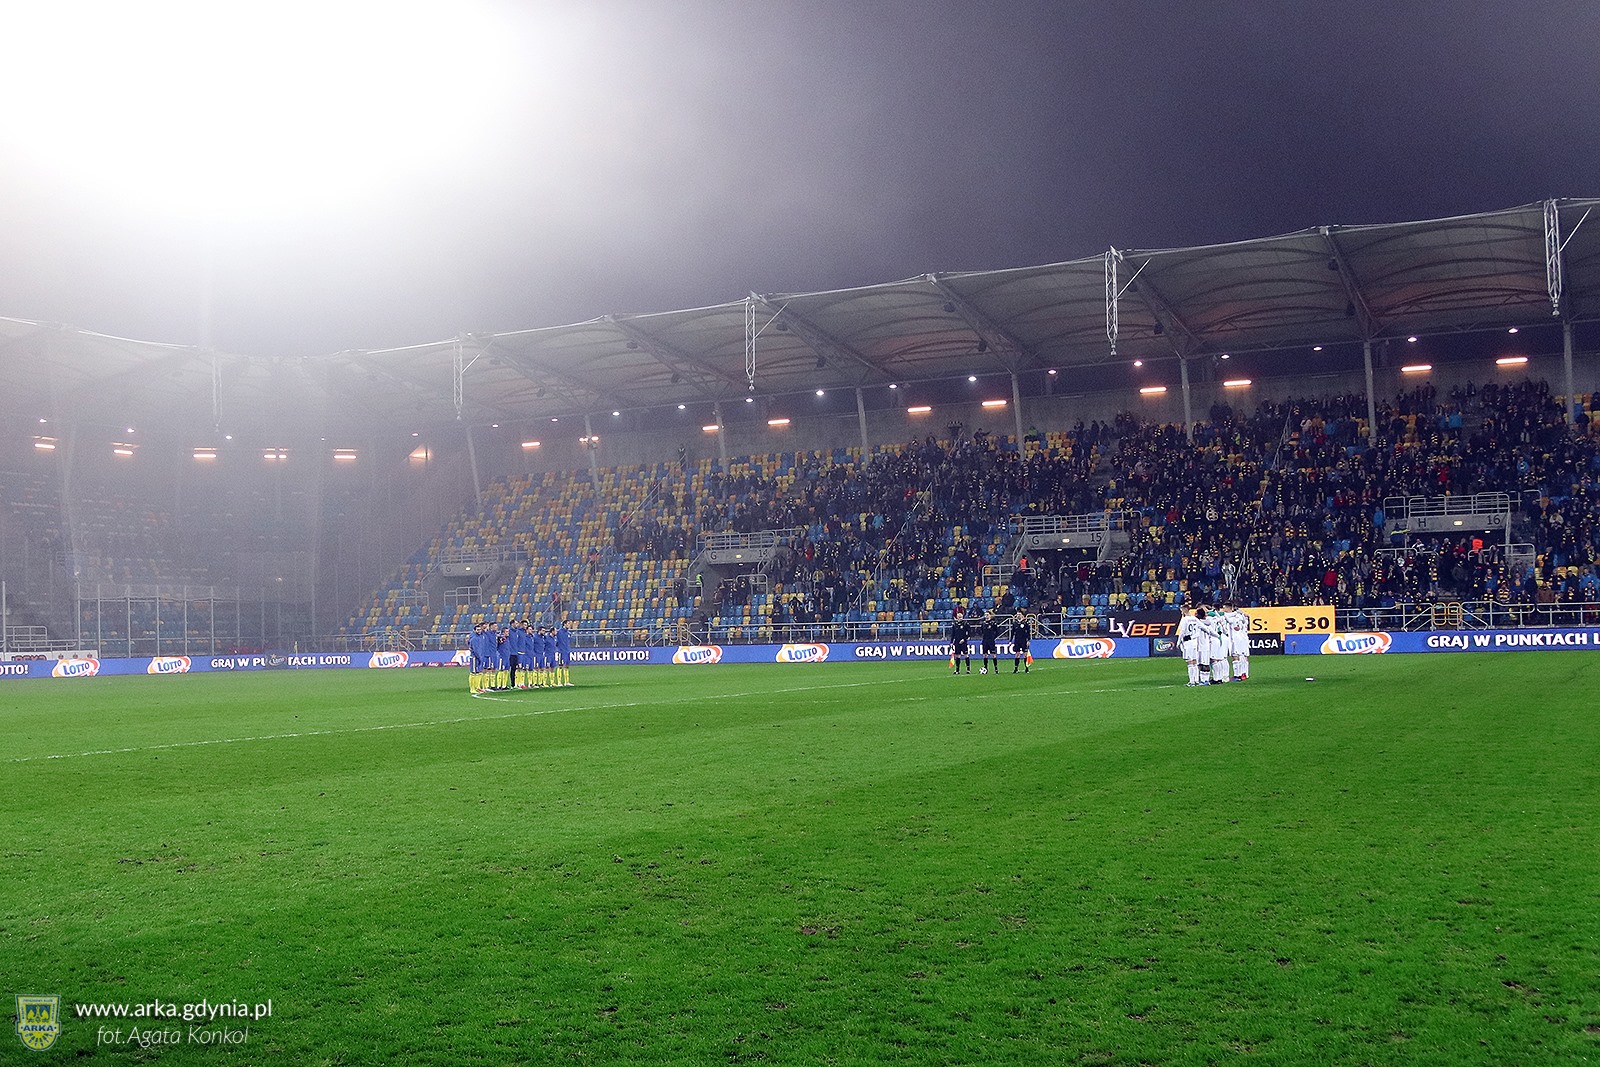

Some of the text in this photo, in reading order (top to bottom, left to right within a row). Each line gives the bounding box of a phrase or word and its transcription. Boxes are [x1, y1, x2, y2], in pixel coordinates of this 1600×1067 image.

[1487, 516, 1500, 525] 16
[1032, 533, 1102, 545] G 15
[710, 551, 717, 560] G
[1284, 617, 1330, 632] 3,30
[1336, 636, 1376, 652] LOTTO
[1427, 635, 1468, 650] GRAJ
[1474, 634, 1491, 647] W
[1498, 633, 1588, 646] PUNKTACH
[555, 650, 649, 661] NKTACH LOTTO!
[683, 648, 712, 662] LOTTO
[788, 647, 817, 660] LOTTO
[855, 646, 887, 659] GRAJ
[889, 645, 903, 656] W
[906, 644, 976, 656] PUNKTH
[1066, 641, 1102, 657] LOTTO
[157, 660, 182, 672] LOTTO
[211, 658, 235, 670] GRAJ
[237, 657, 249, 667] W
[319, 655, 351, 665] LOTTO!
[377, 654, 400, 667] LOTTO
[62, 662, 90, 675] LOTTO
